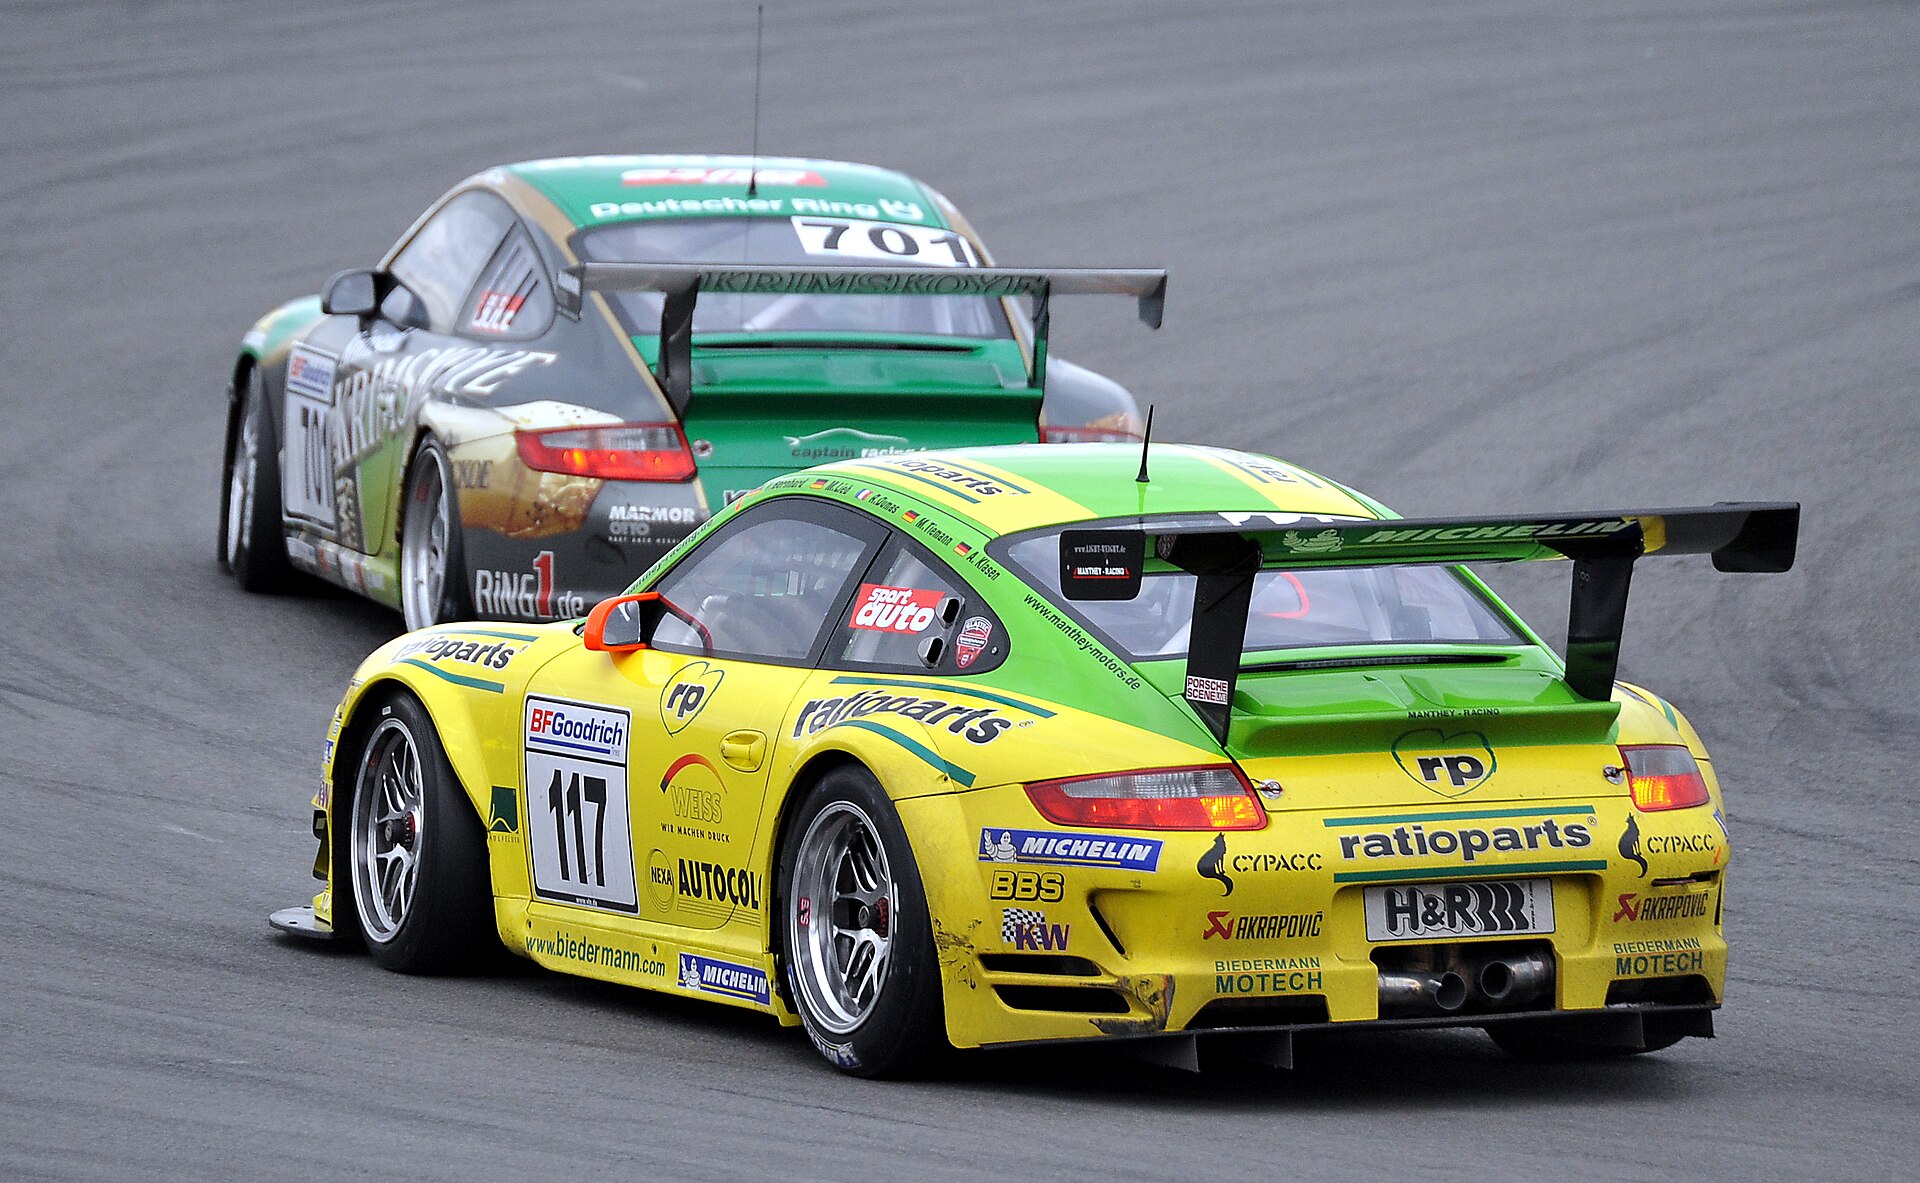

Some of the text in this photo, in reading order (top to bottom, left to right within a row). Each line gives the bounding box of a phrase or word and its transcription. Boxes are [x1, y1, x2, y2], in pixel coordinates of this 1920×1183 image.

[591, 197, 784, 219] Deutscher
[801, 222, 972, 268] 701
[609, 505, 695, 522] MARMOR
[1359, 519, 1638, 544] MICHELIN
[868, 587, 914, 604] sport
[855, 602, 935, 632] auto
[1023, 593, 1141, 690] www.manthey-motors.de
[1187, 677, 1228, 693] PORSCHE
[1187, 687, 1216, 701] SCENE
[666, 683, 705, 718] rp
[1408, 709, 1456, 719] MANTHEY
[530, 708, 624, 748] BFGoodrich
[793, 689, 1013, 744] ratioparts
[1416, 755, 1484, 786] rp
[671, 784, 723, 824] WEISS
[548, 768, 608, 888] 117
[660, 822, 731, 844] WIR MACHEN DRUCK
[1339, 818, 1592, 862] ratioparts
[1021, 836, 1153, 862] MICHELIN
[1647, 834, 1715, 854] CYPACC
[1233, 852, 1323, 874] CYPACC
[650, 857, 763, 911] NEXA AUTOCOL
[990, 870, 1065, 902] BBS
[1015, 923, 1070, 951] KW
[1613, 937, 1701, 954] BIEDERMANN
[525, 930, 667, 977] www.biedermann.com
[1215, 956, 1321, 972] BIEDERMANN
[1616, 951, 1703, 976] MOTECH
[702, 963, 768, 995] MICHELIN
[1215, 971, 1323, 994] MOTECH
